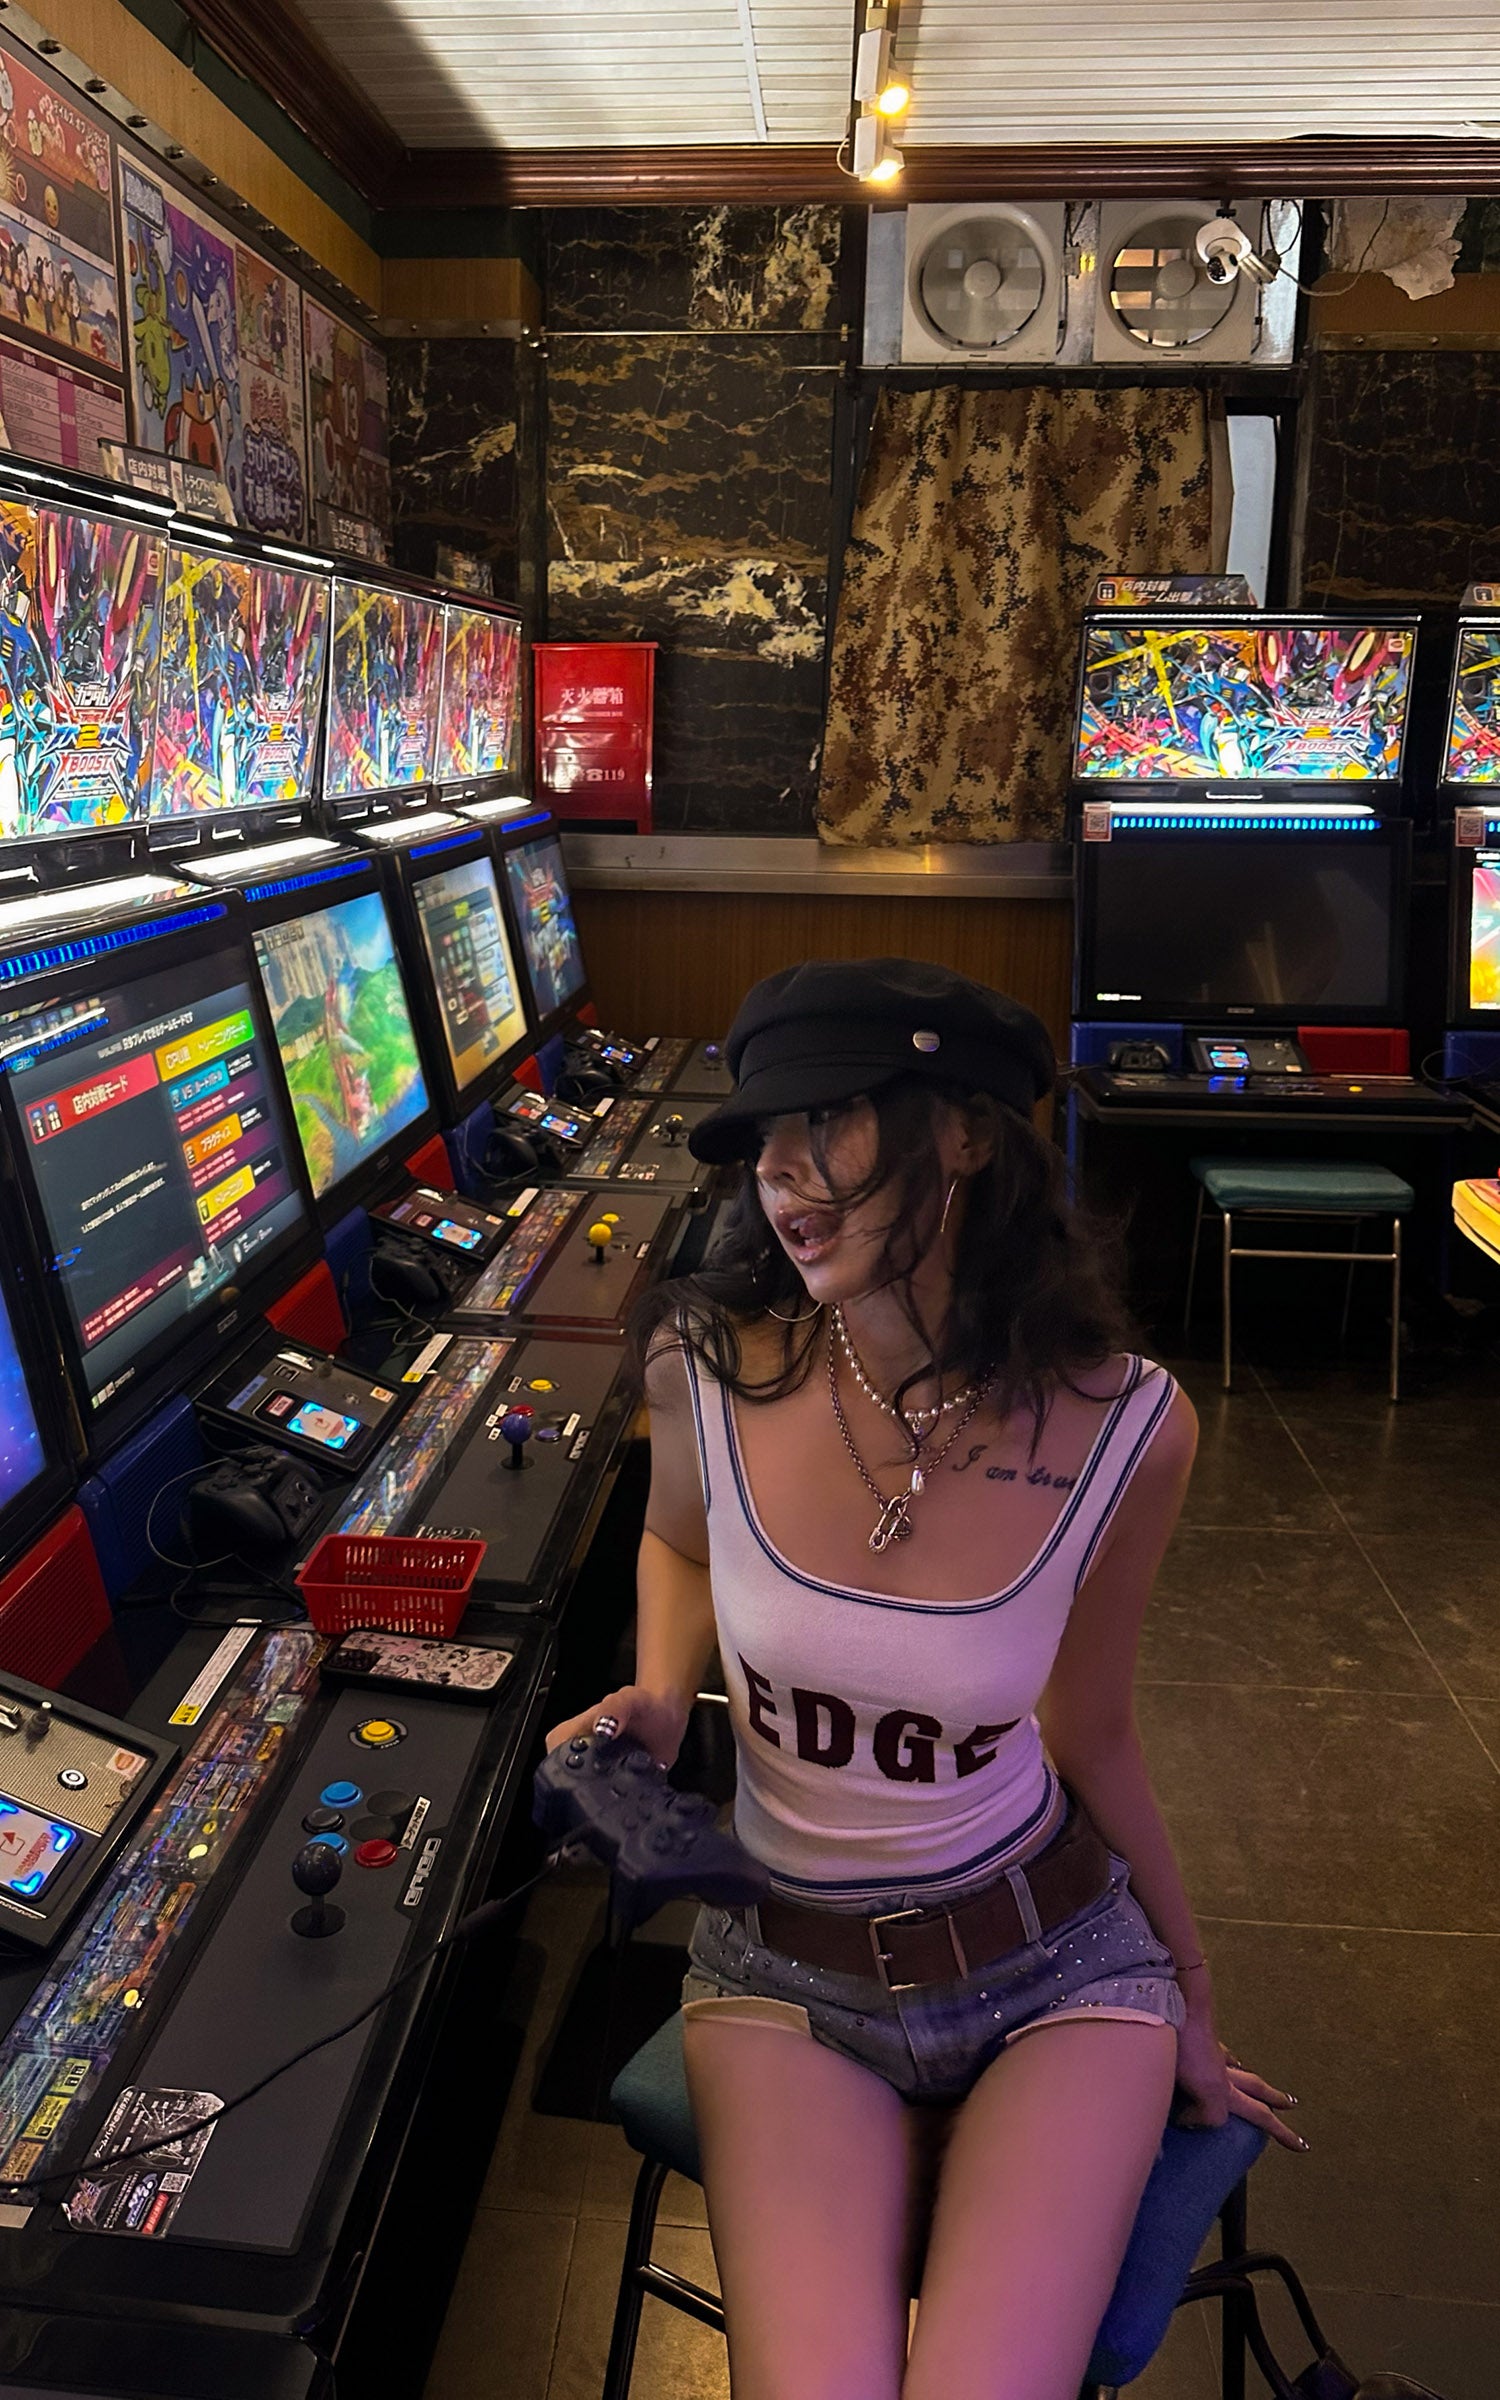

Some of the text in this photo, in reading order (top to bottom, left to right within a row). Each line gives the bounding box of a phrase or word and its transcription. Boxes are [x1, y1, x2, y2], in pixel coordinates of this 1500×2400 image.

[74, 724, 102, 749] 2
[604, 768, 625, 781] 119
[986, 1466, 1018, 1481] am
[737, 1651, 1021, 1783] EDGE
